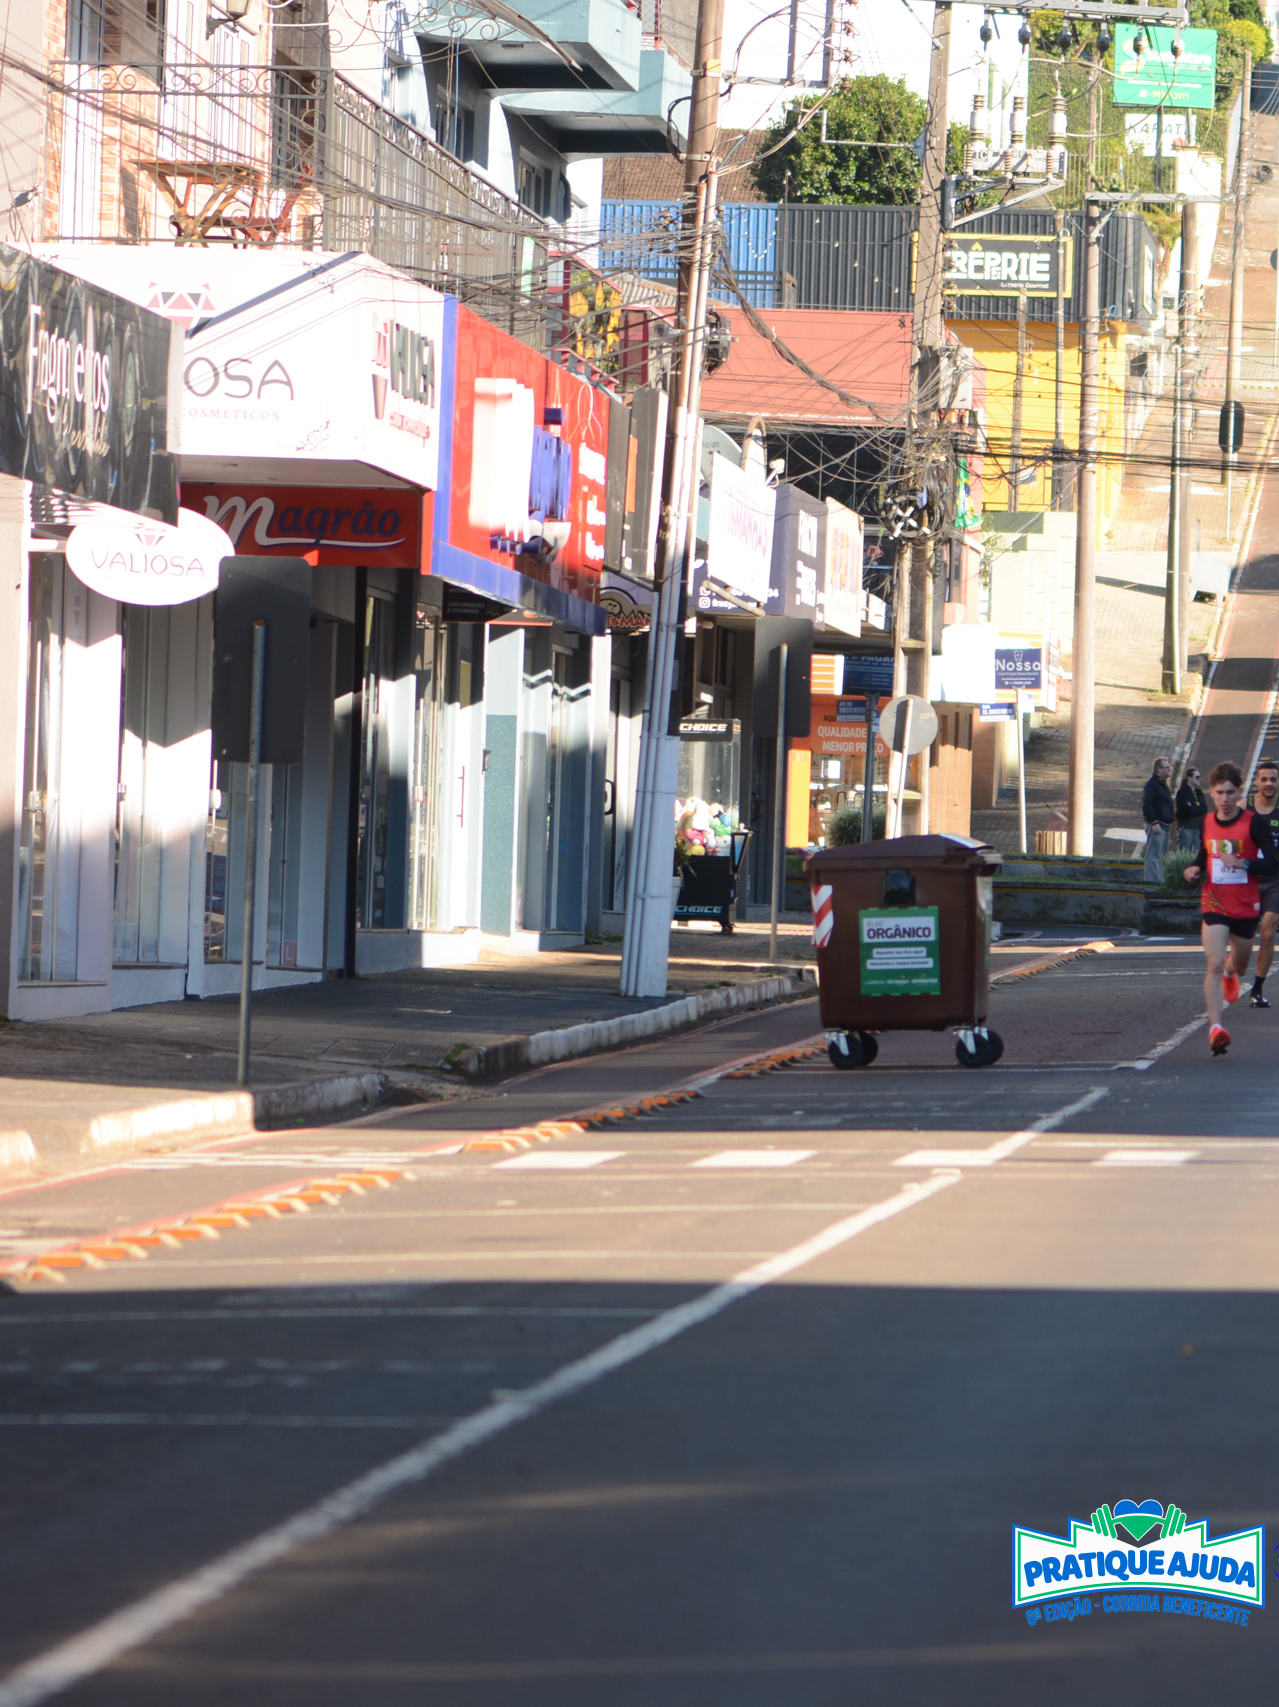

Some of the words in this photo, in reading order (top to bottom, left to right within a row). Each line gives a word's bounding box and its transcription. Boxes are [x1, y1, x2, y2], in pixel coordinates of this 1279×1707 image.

[91, 550, 204, 578] VALIOSA
[996, 659, 1041, 671] Nossa
[679, 723, 727, 732] CHOICE
[818, 726, 868, 738] QUALIDADE
[822, 741, 855, 752] MENOR
[856, 742, 884, 756] PRÇO
[674, 905, 722, 914] CHOICE
[867, 924, 931, 939] ORGÂNICO
